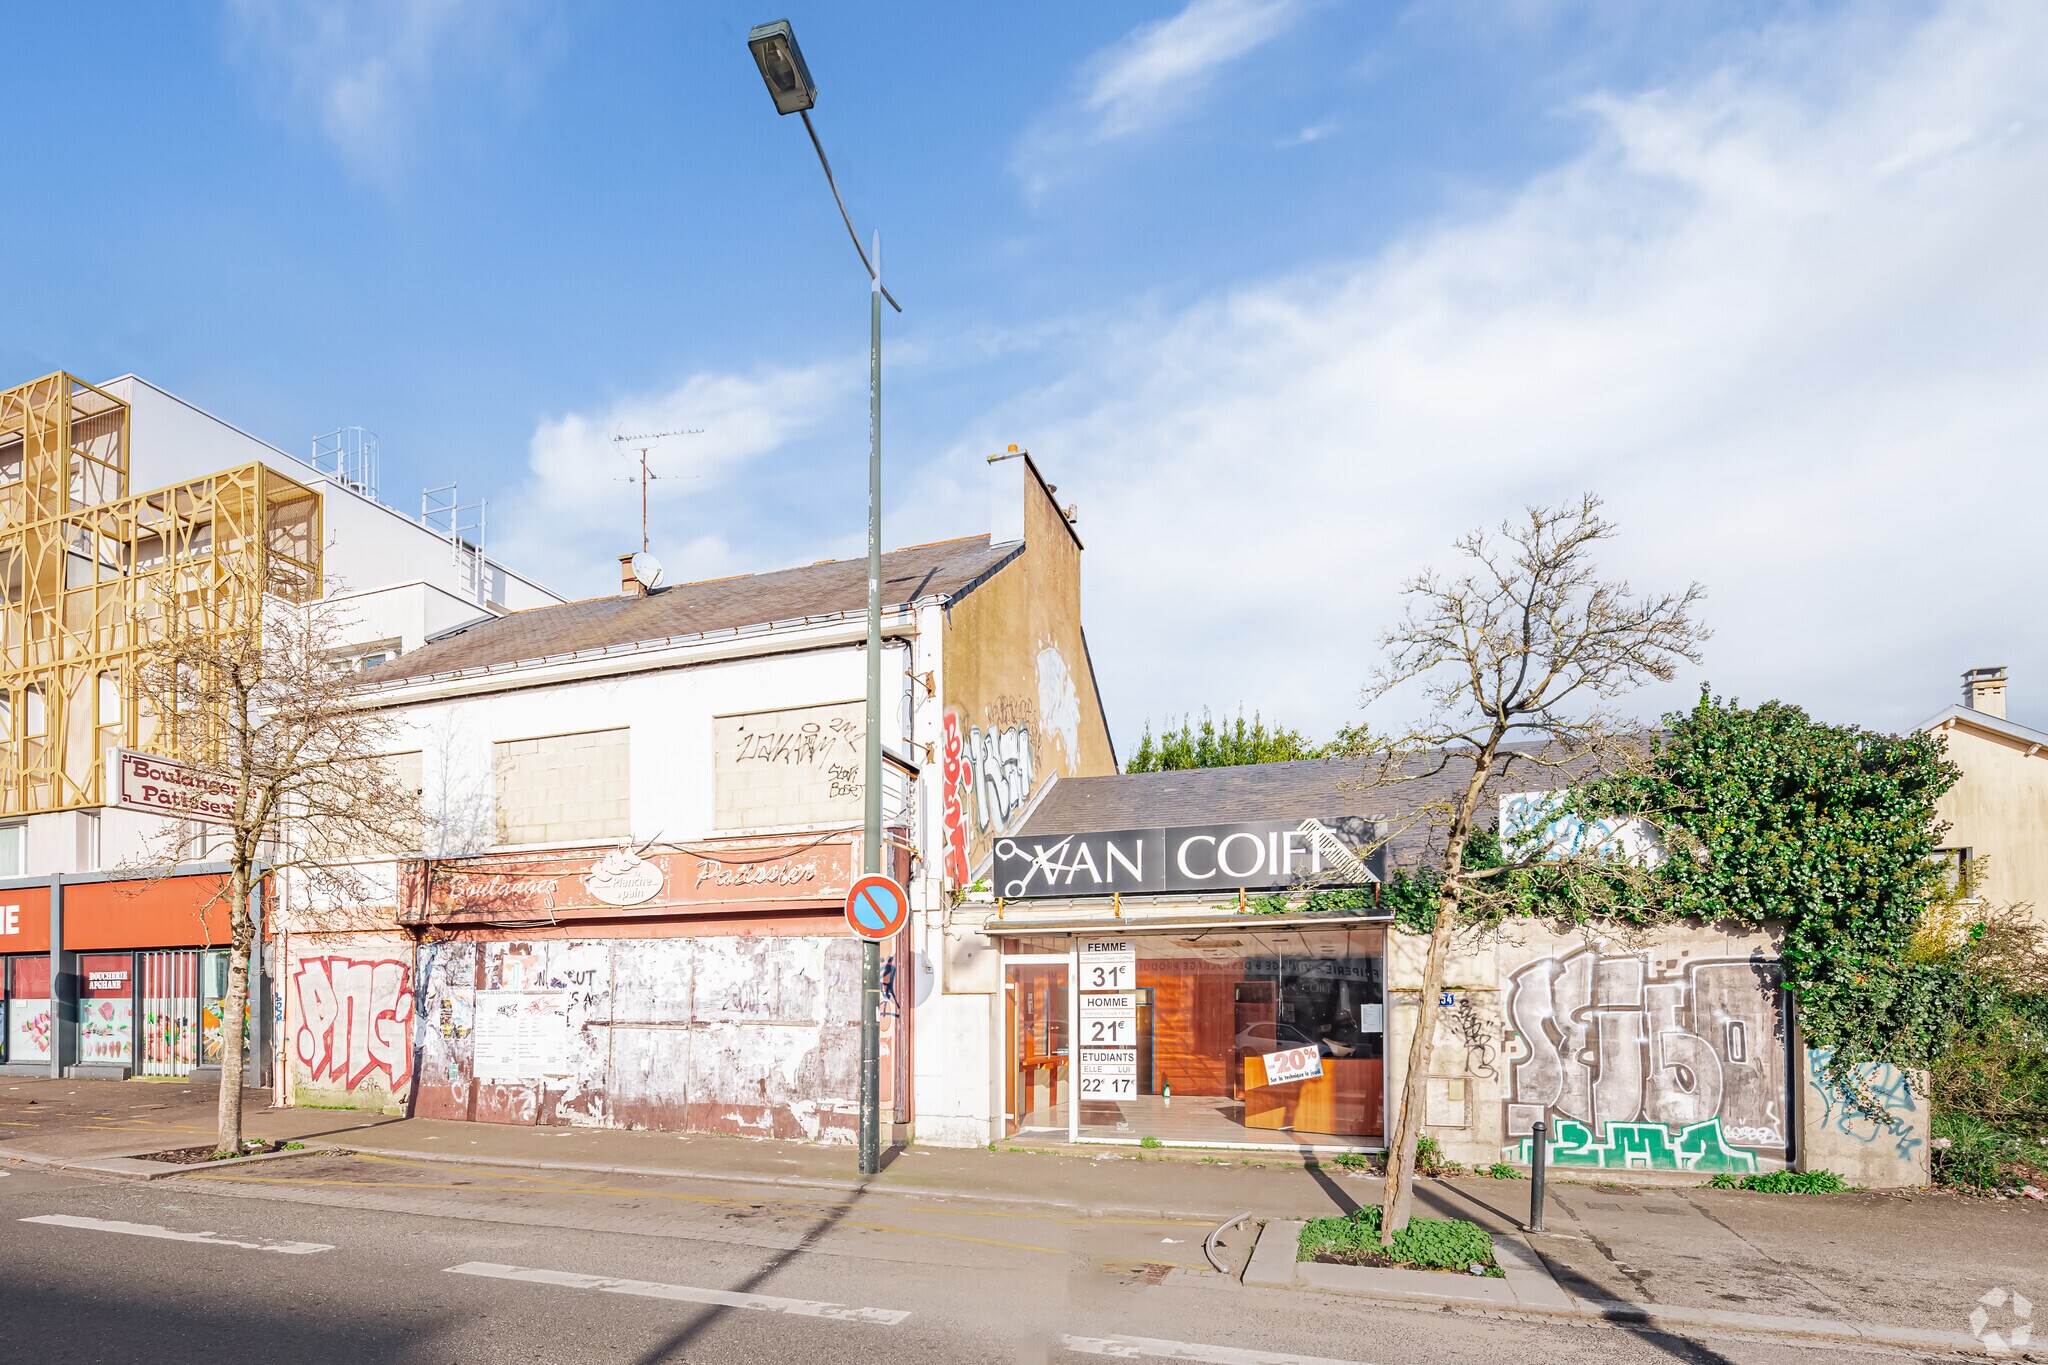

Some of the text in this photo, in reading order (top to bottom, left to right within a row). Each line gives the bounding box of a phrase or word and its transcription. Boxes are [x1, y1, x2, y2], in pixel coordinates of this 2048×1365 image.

[133, 760, 257, 799] Boulangere
[612, 877, 652, 888] Planche
[622, 888, 644, 901] pain
[1088, 942, 1126, 951] FEMME
[89, 971, 128, 980] BOUCHERIE
[1087, 998, 1128, 1007] HOMME
[1082, 1052, 1134, 1062] ETUDIANTS
[1083, 1065, 1103, 1073] ELLE
